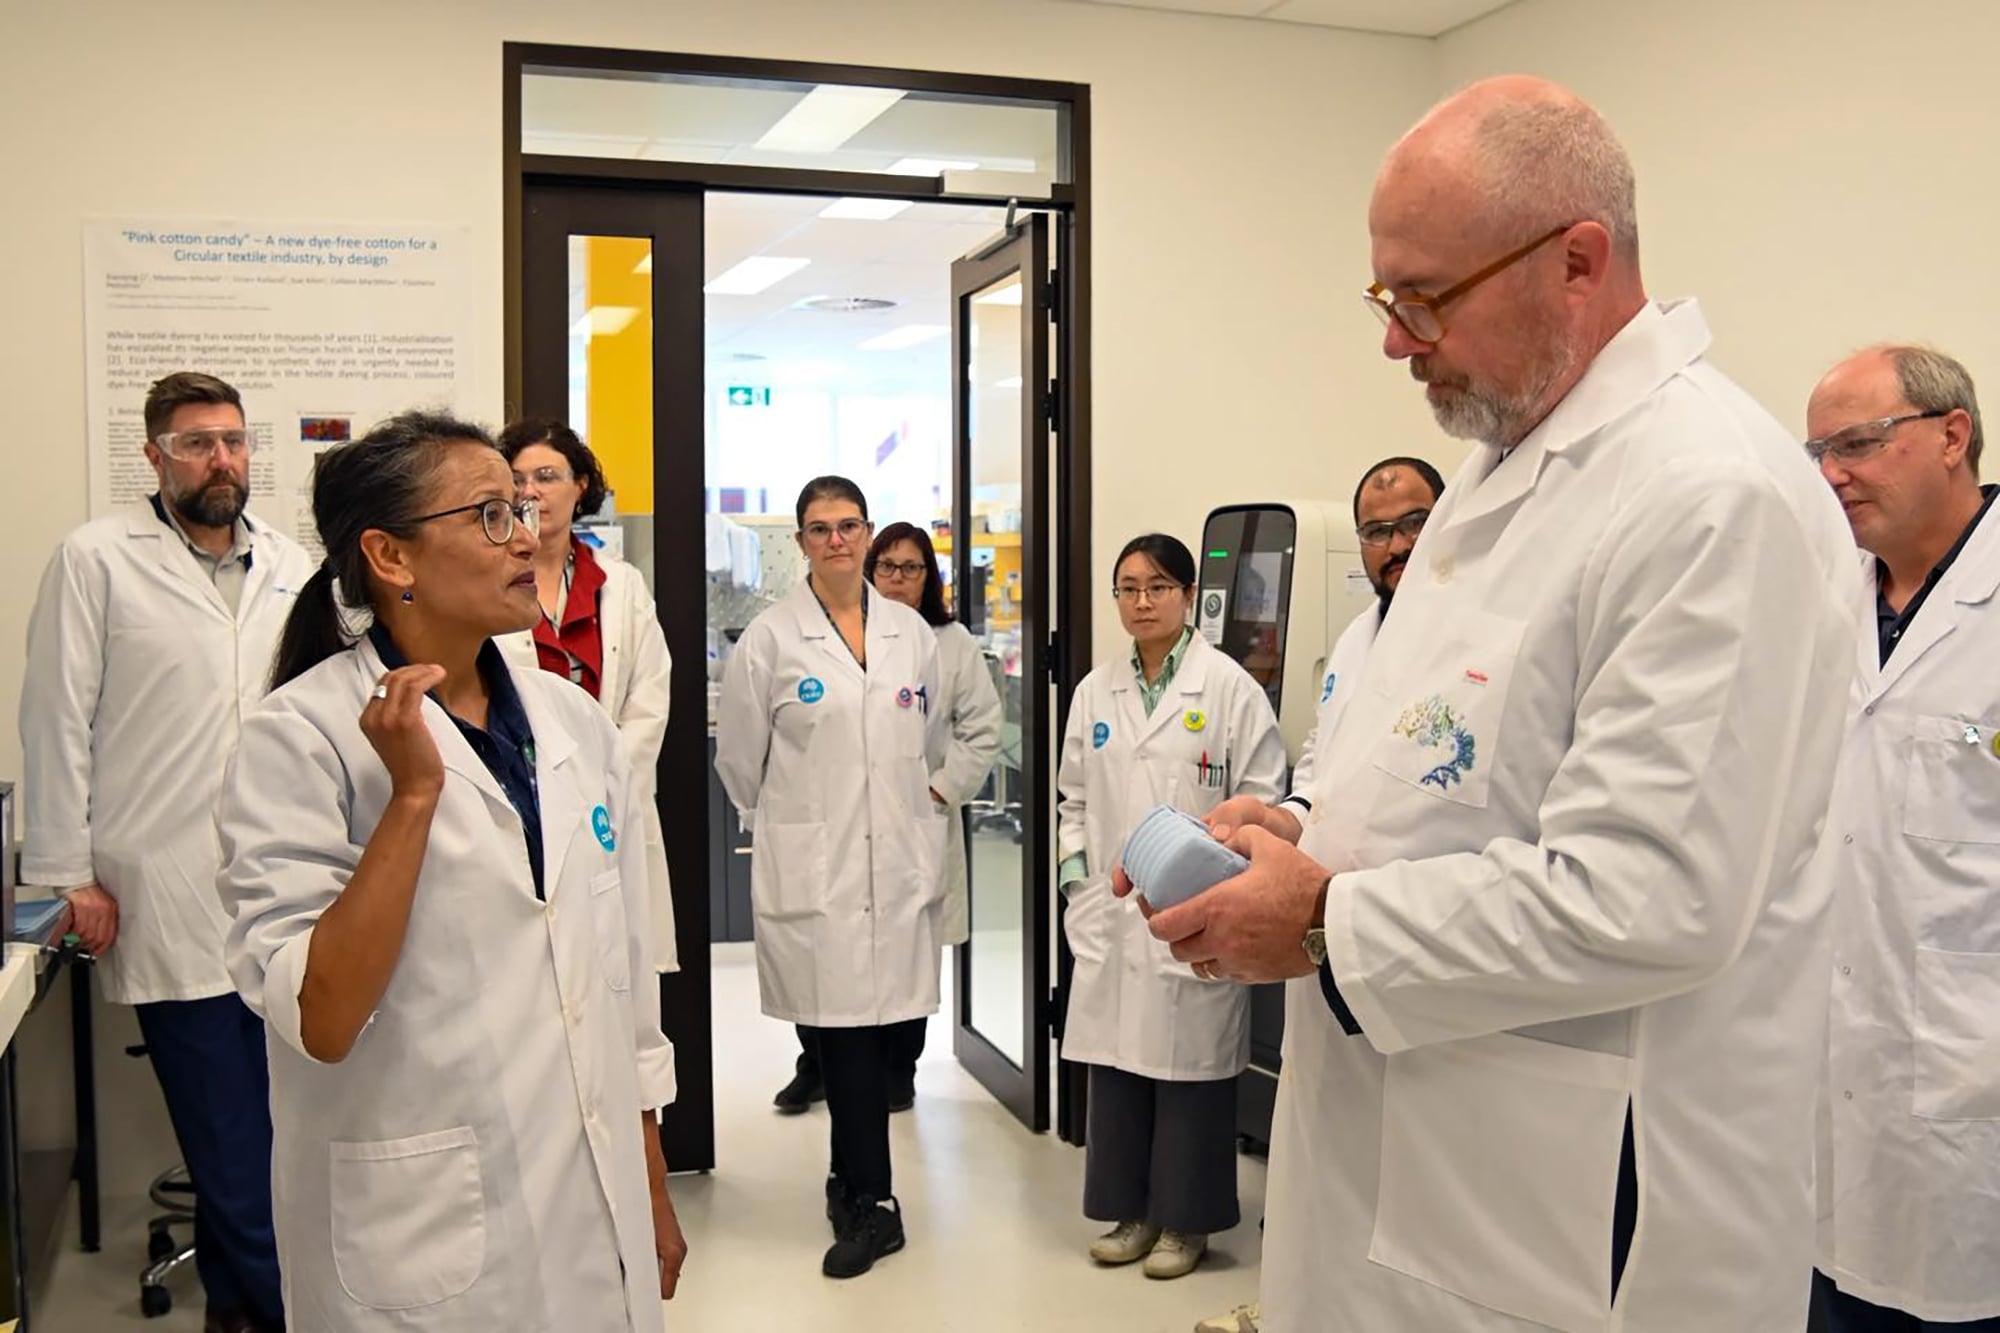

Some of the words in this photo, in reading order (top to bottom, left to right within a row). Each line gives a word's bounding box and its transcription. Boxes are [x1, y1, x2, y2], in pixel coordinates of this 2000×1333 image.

[159, 232, 201, 245] cotton
[266, 234, 275, 246] A
[278, 236, 305, 247] new
[309, 235, 361, 249] dye-free
[364, 236, 406, 249] cotton
[408, 236, 426, 250] for
[430, 240, 437, 250] a
[173, 249, 223, 263] Circular
[227, 250, 267, 263] textile
[271, 251, 326, 266] industry,
[328, 252, 343, 266] by
[347, 253, 389, 267] design
